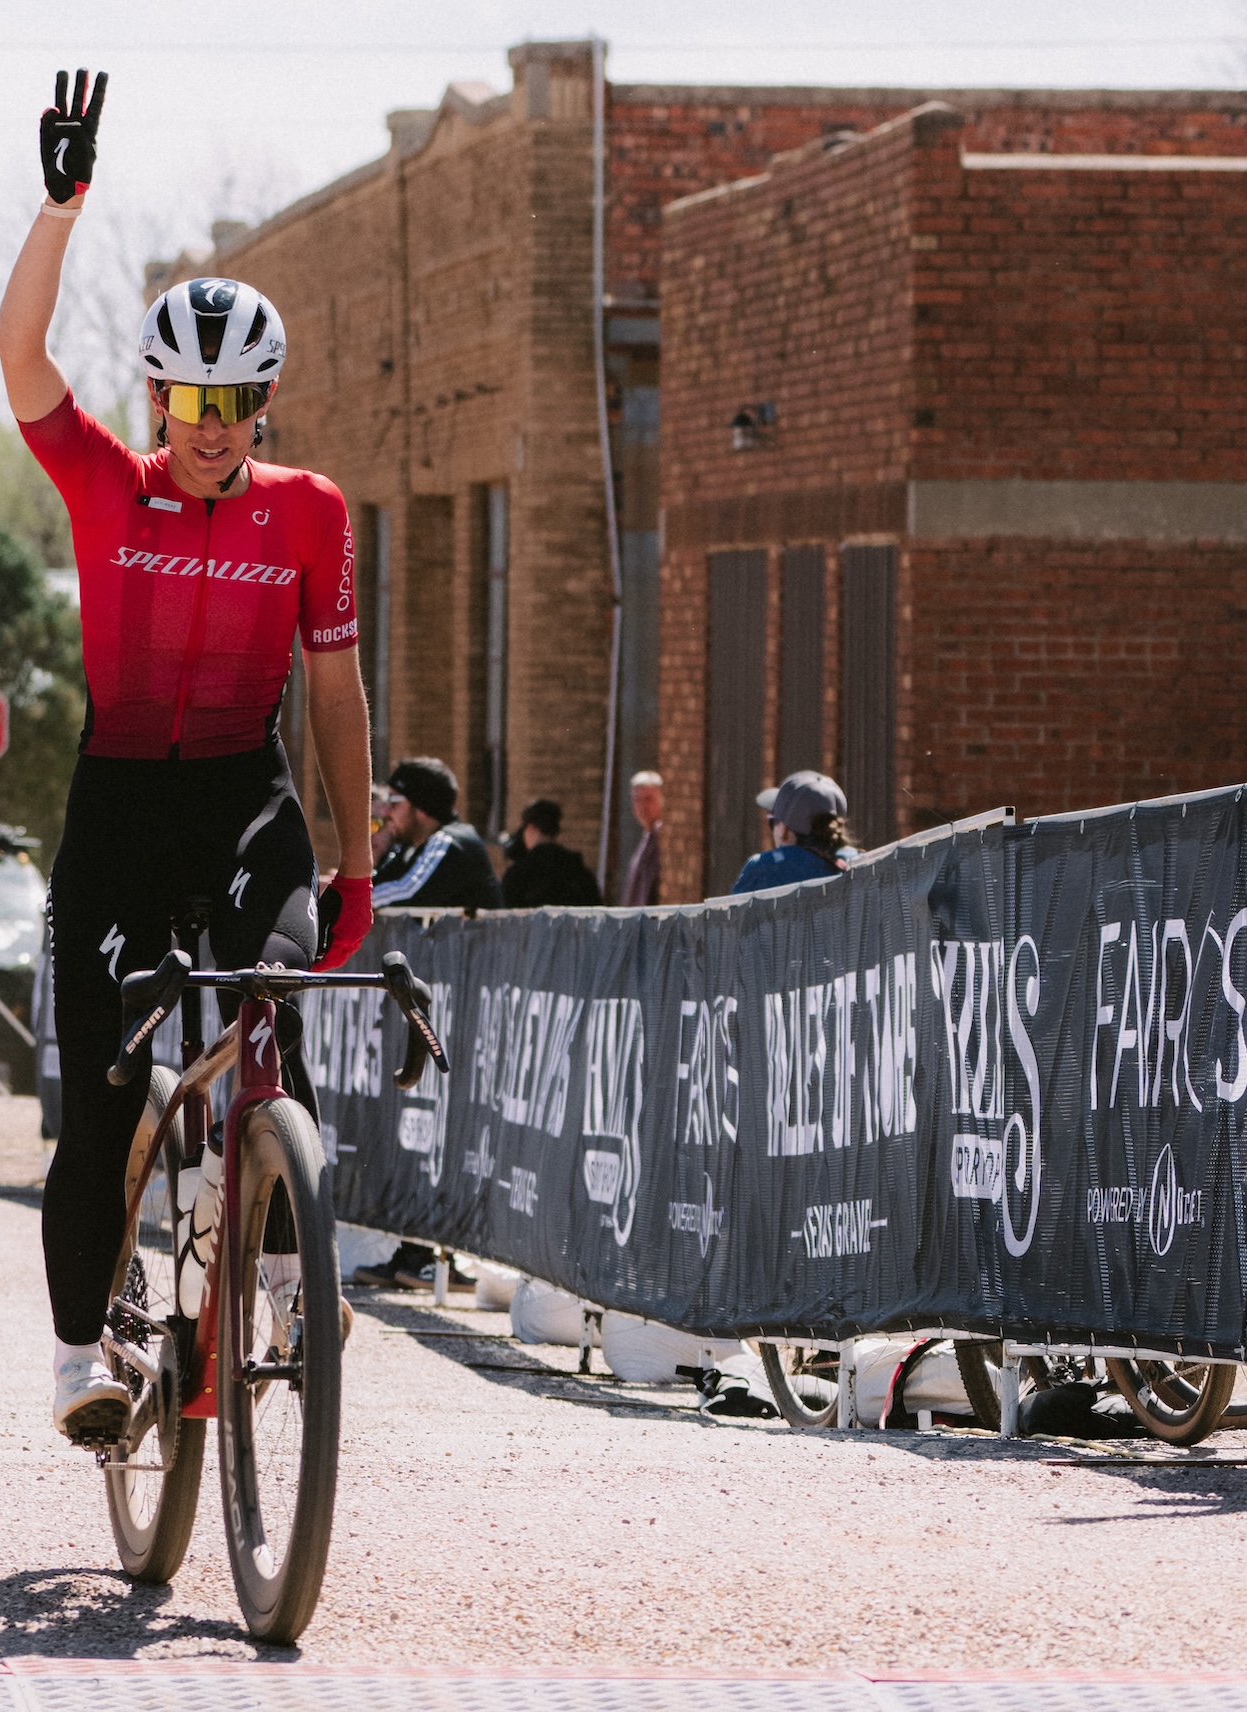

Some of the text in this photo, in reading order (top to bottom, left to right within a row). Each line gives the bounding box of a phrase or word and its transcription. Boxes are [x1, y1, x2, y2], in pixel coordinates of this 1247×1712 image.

[109, 546, 297, 585] SPECIALIZED
[125, 1006, 165, 1054] SRAM
[804, 1205, 833, 1258] TEXAS
